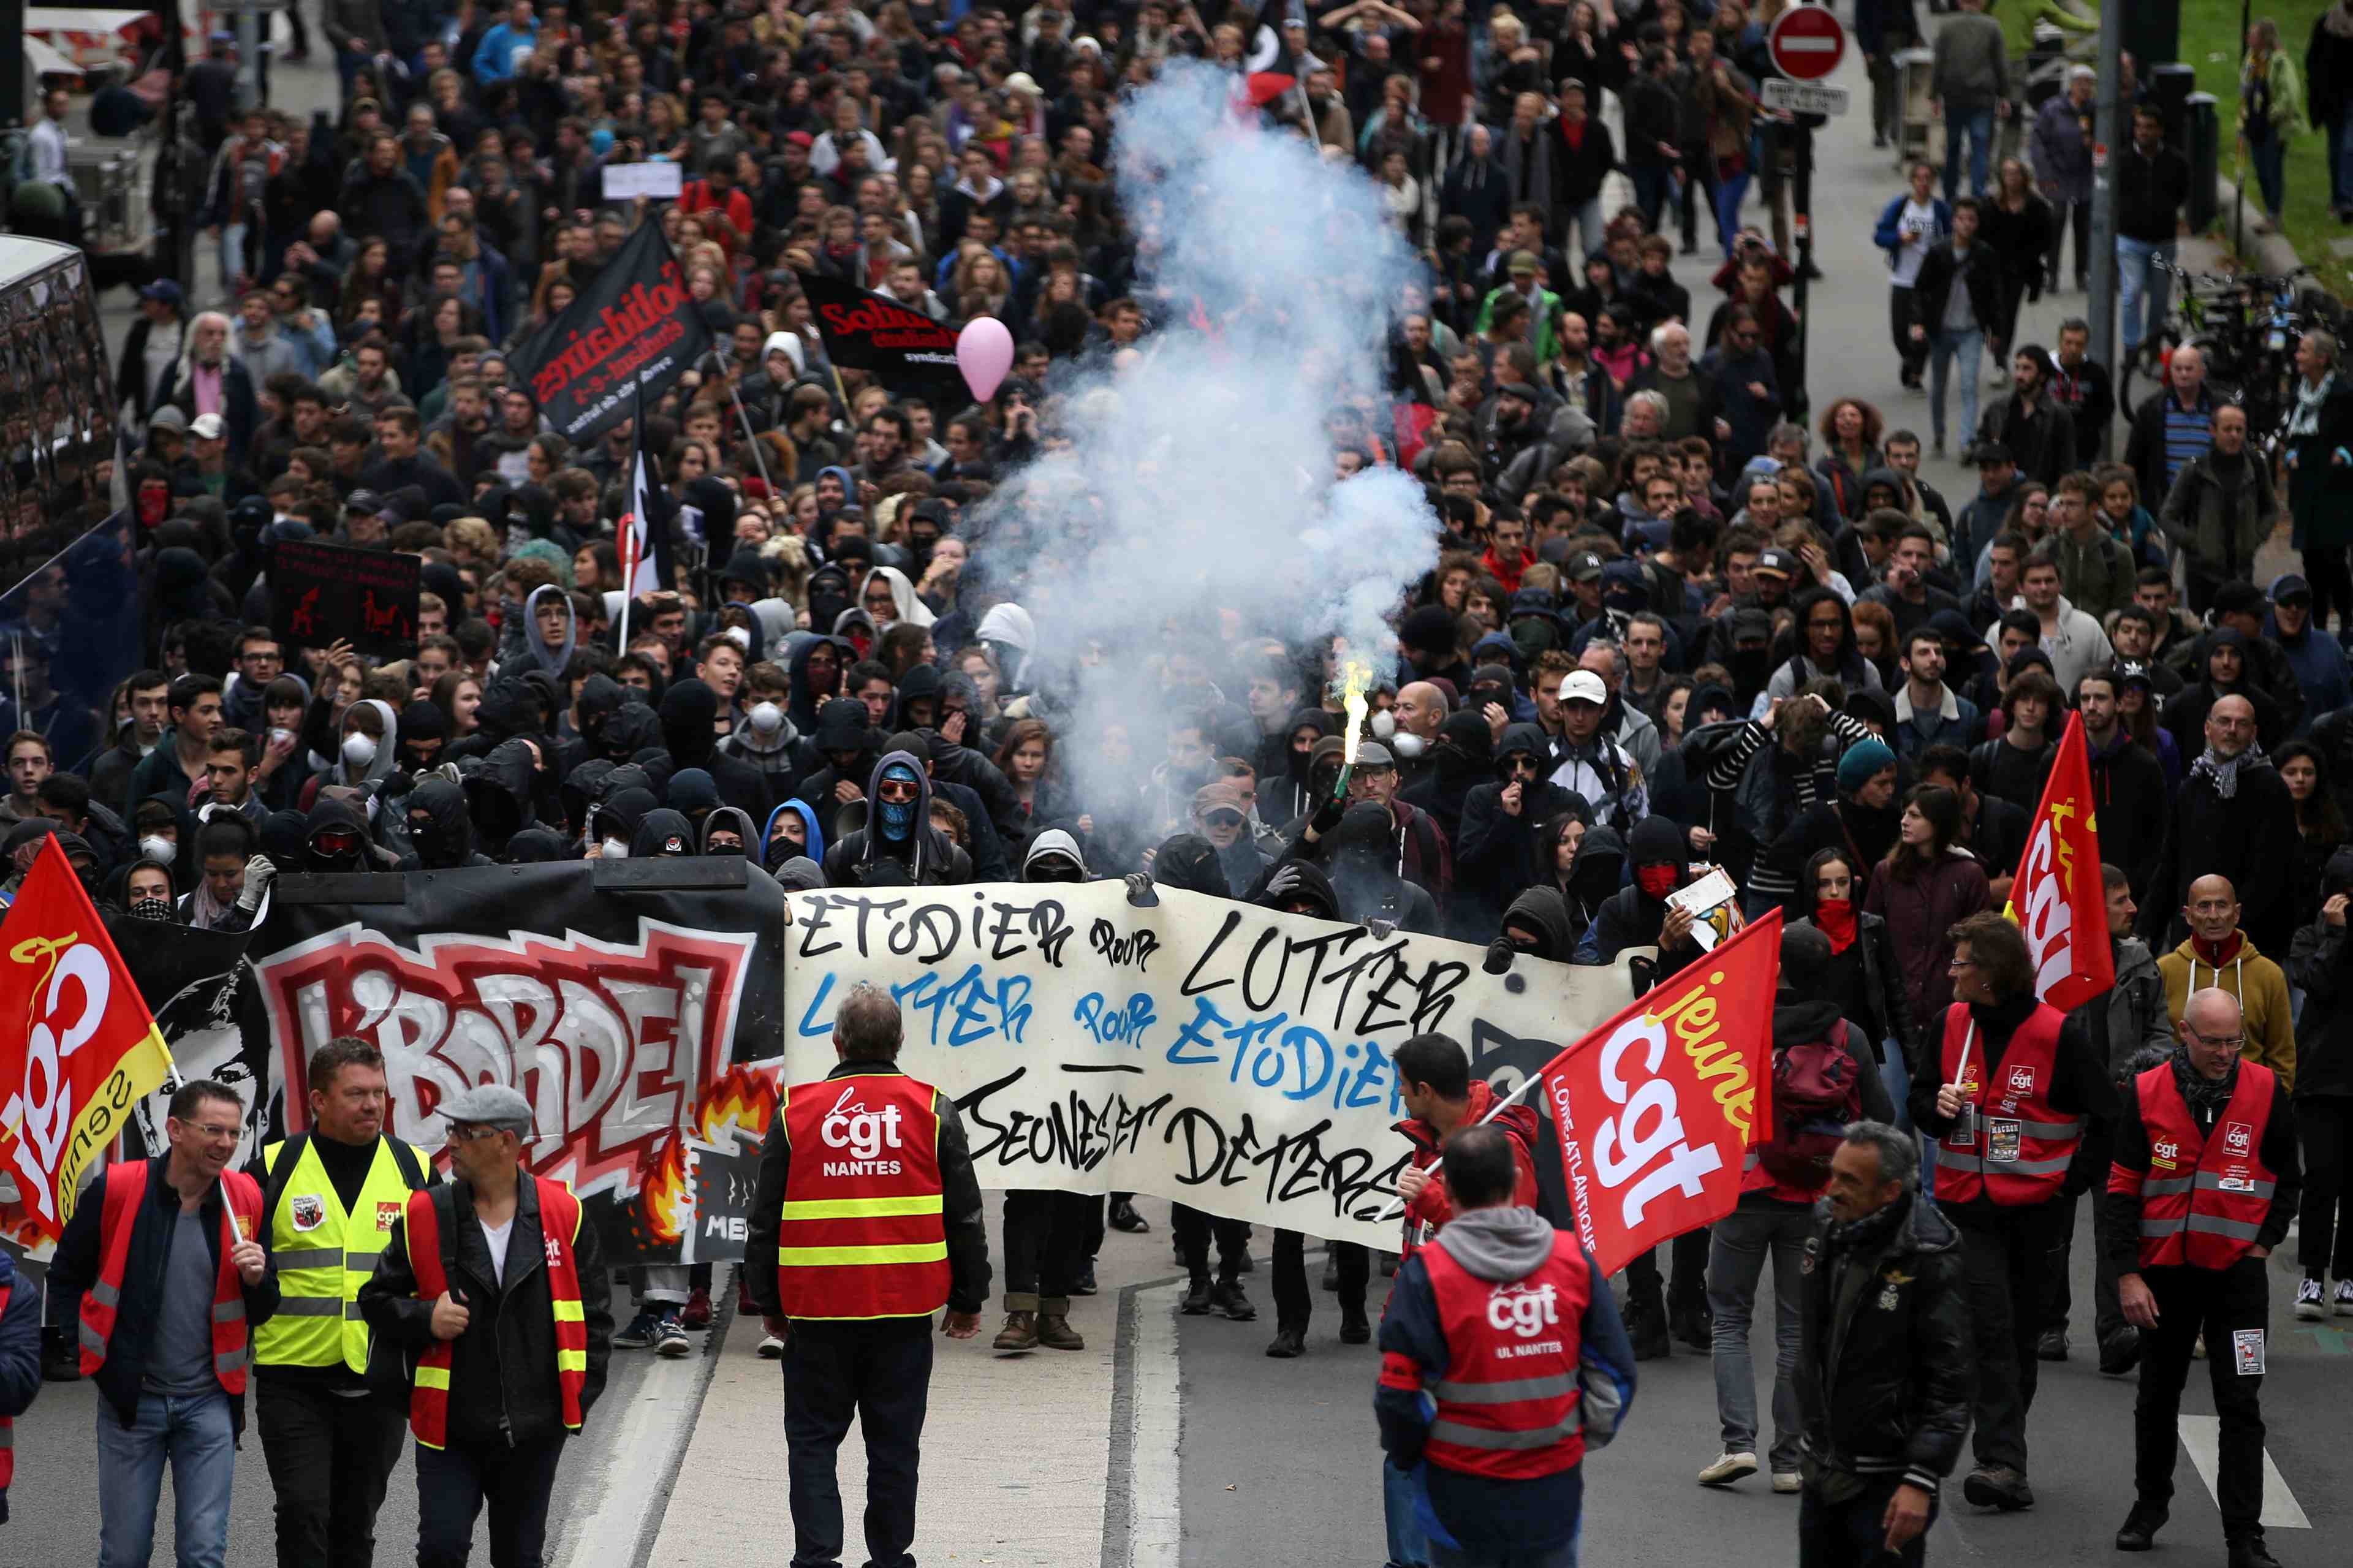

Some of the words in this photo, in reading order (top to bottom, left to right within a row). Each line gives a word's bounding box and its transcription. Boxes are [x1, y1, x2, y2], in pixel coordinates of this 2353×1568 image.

[1180, 910, 1470, 1036] LUTTER
[798, 963, 1034, 1047] LTTER
[2011, 1075, 2032, 1089] cgt
[821, 1104, 902, 1159] cgt
[1593, 1014, 1723, 1230] cgt
[2154, 1142, 2178, 1159] cgt
[2227, 1133, 2248, 1148] cgt
[823, 1161, 901, 1177] NANTES
[705, 1214, 749, 1243] ME
[1487, 1284, 1559, 1338] cgt
[1497, 1347, 1514, 1358] UL
[1515, 1341, 1563, 1357] NANTES
